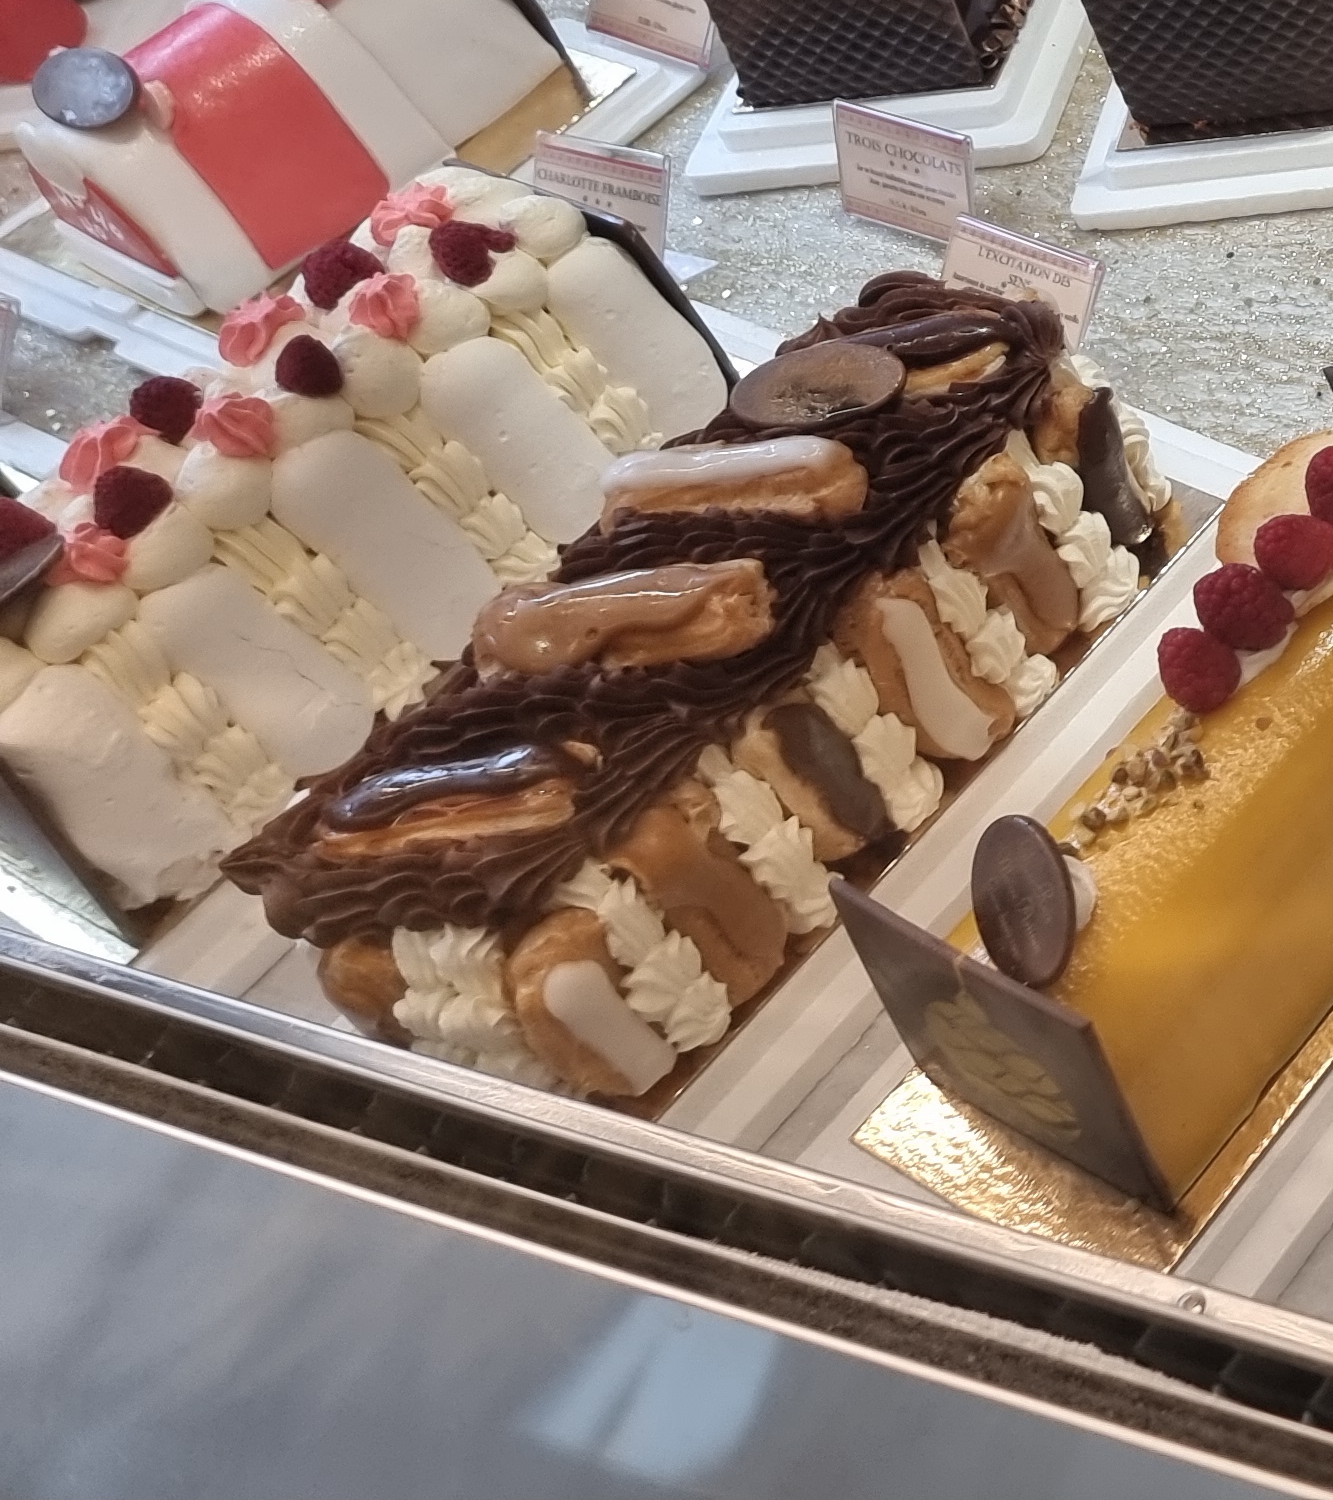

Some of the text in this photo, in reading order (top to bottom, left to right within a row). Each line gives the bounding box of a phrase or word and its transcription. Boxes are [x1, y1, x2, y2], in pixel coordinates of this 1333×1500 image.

[845, 130, 962, 176] TROIS CHOCOLATS
[1052, 274, 1072, 288] DES
